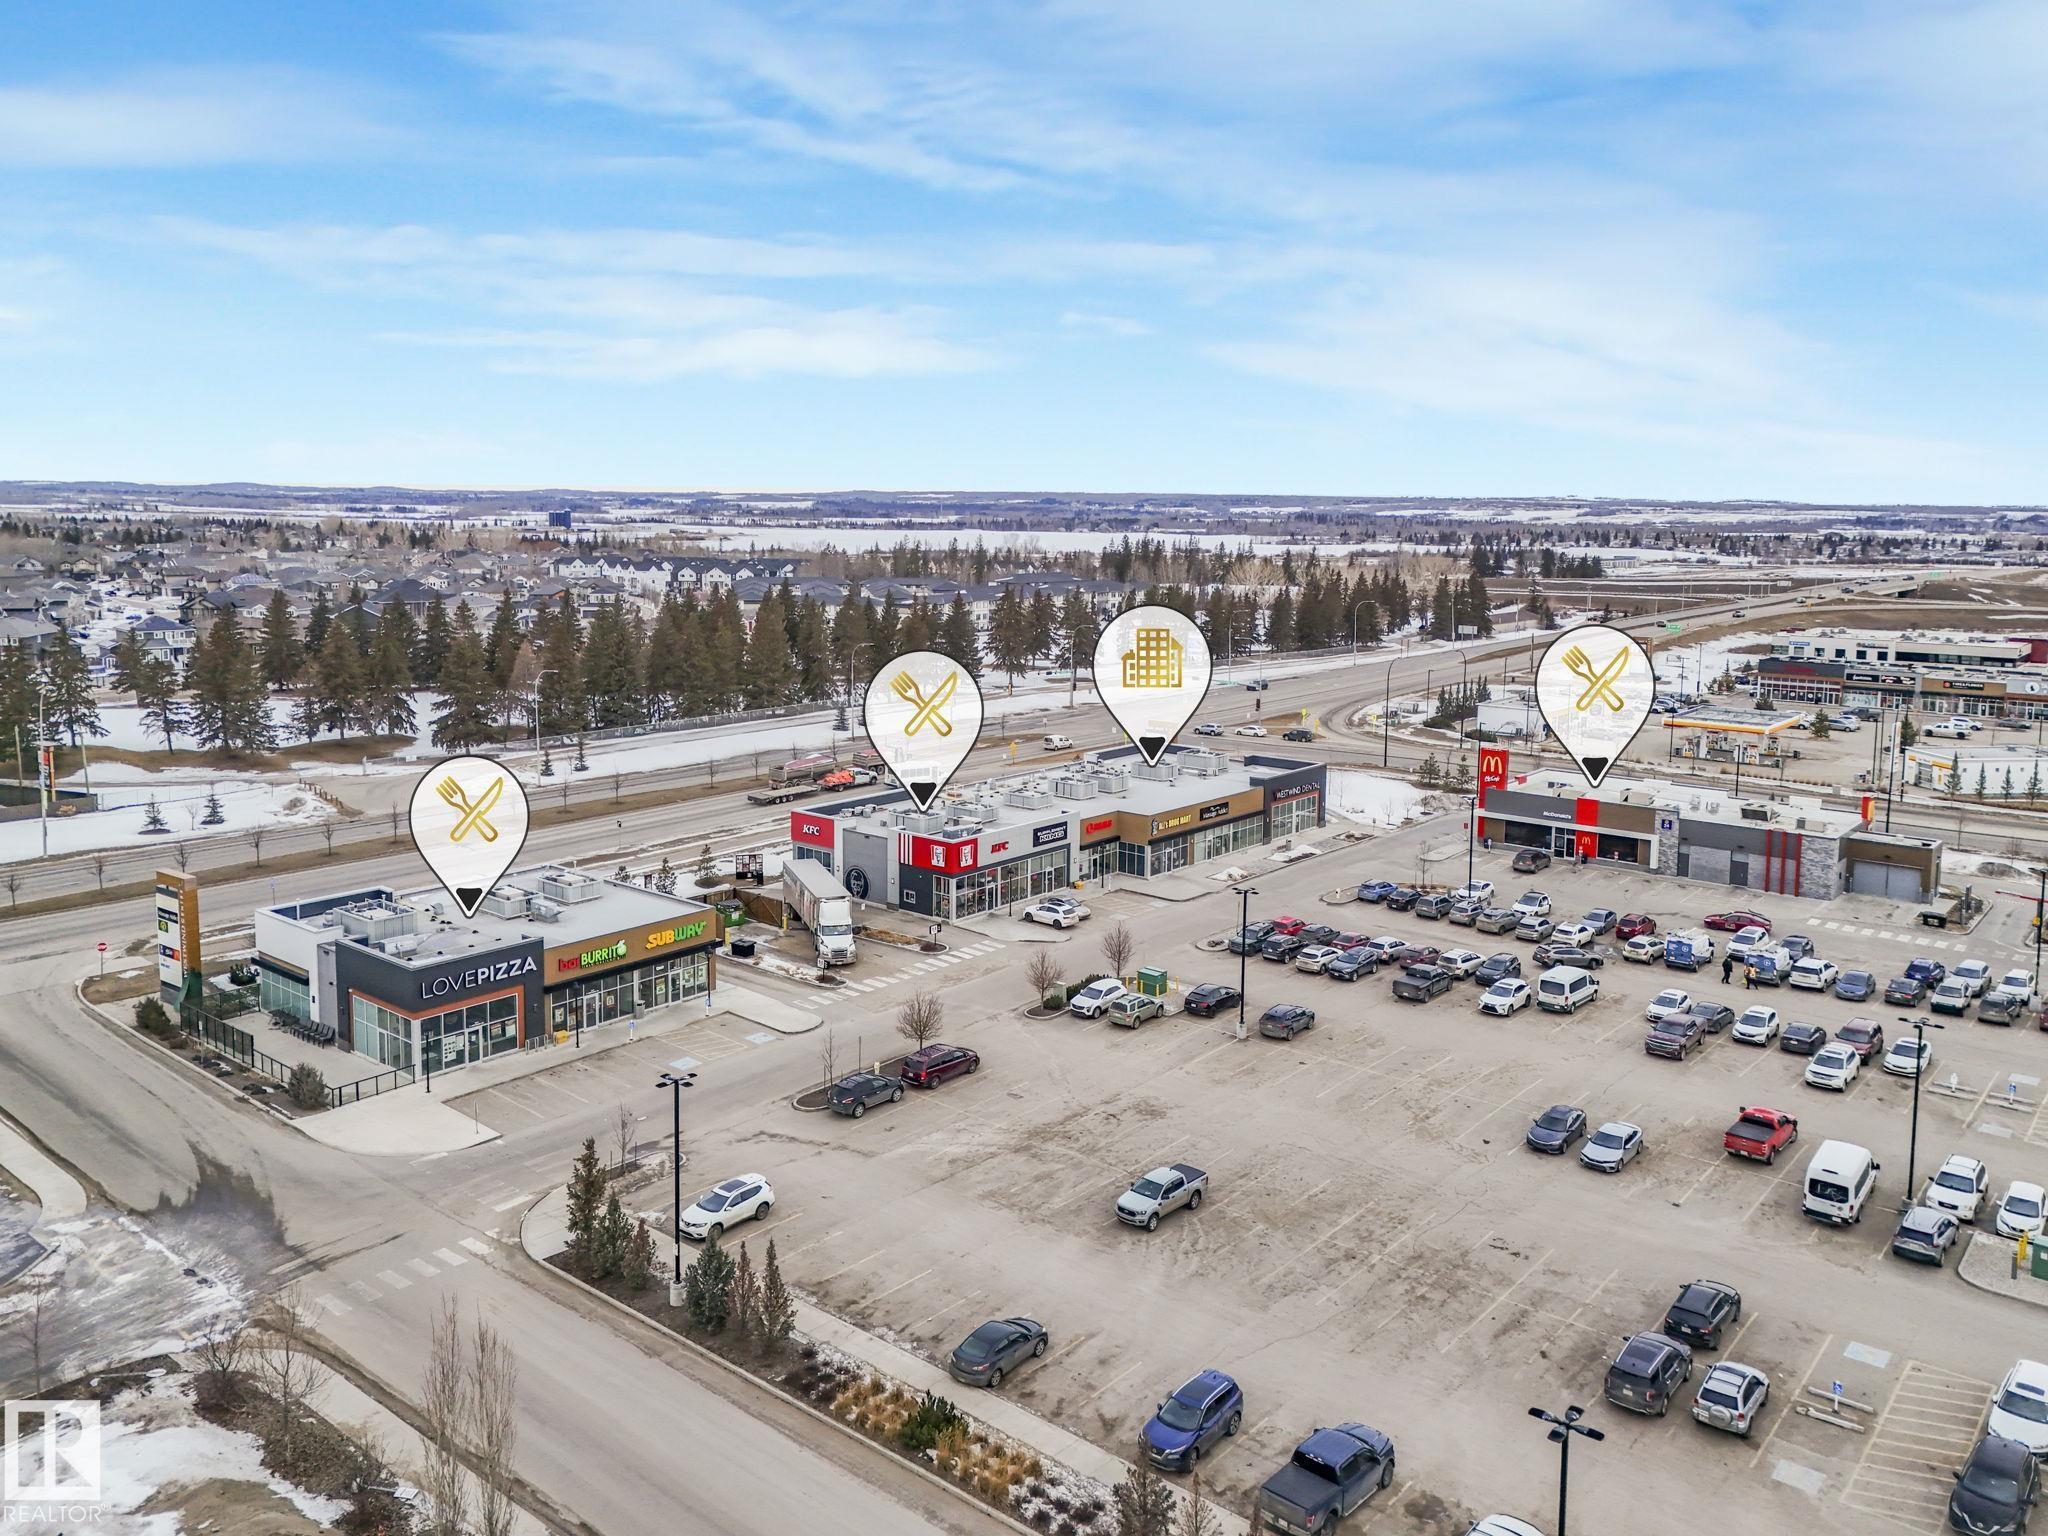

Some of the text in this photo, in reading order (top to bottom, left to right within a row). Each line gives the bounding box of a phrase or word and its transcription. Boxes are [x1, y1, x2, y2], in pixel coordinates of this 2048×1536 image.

[802, 824, 820, 836] KFC
[991, 840, 1009, 854] KFC
[645, 920, 708, 950] SUBWAY
